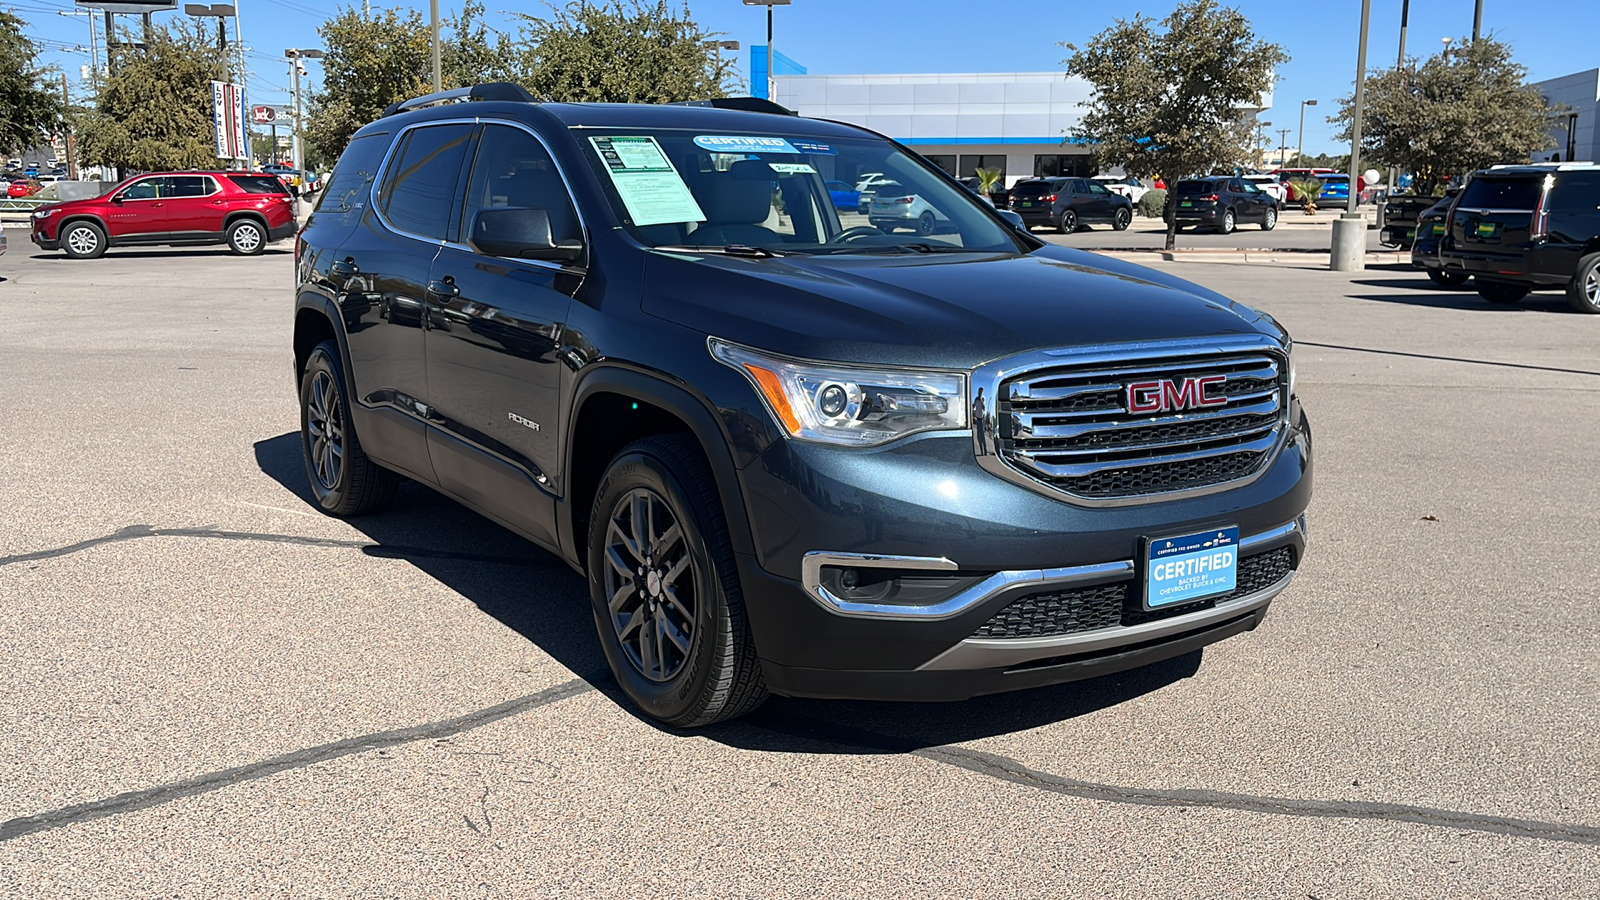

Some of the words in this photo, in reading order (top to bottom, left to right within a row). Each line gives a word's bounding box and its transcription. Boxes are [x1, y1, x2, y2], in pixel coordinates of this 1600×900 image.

[253, 107, 275, 121] Jack
[697, 137, 785, 147] CERTIFIED
[1126, 374, 1228, 414] GMC
[1157, 546, 1178, 555] CERTIFIED
[1154, 552, 1233, 581] CERTIFIED
[1160, 583, 1191, 595] CHEVROLET
[1193, 580, 1209, 589] BUICK
[1178, 576, 1200, 585] BACKED
